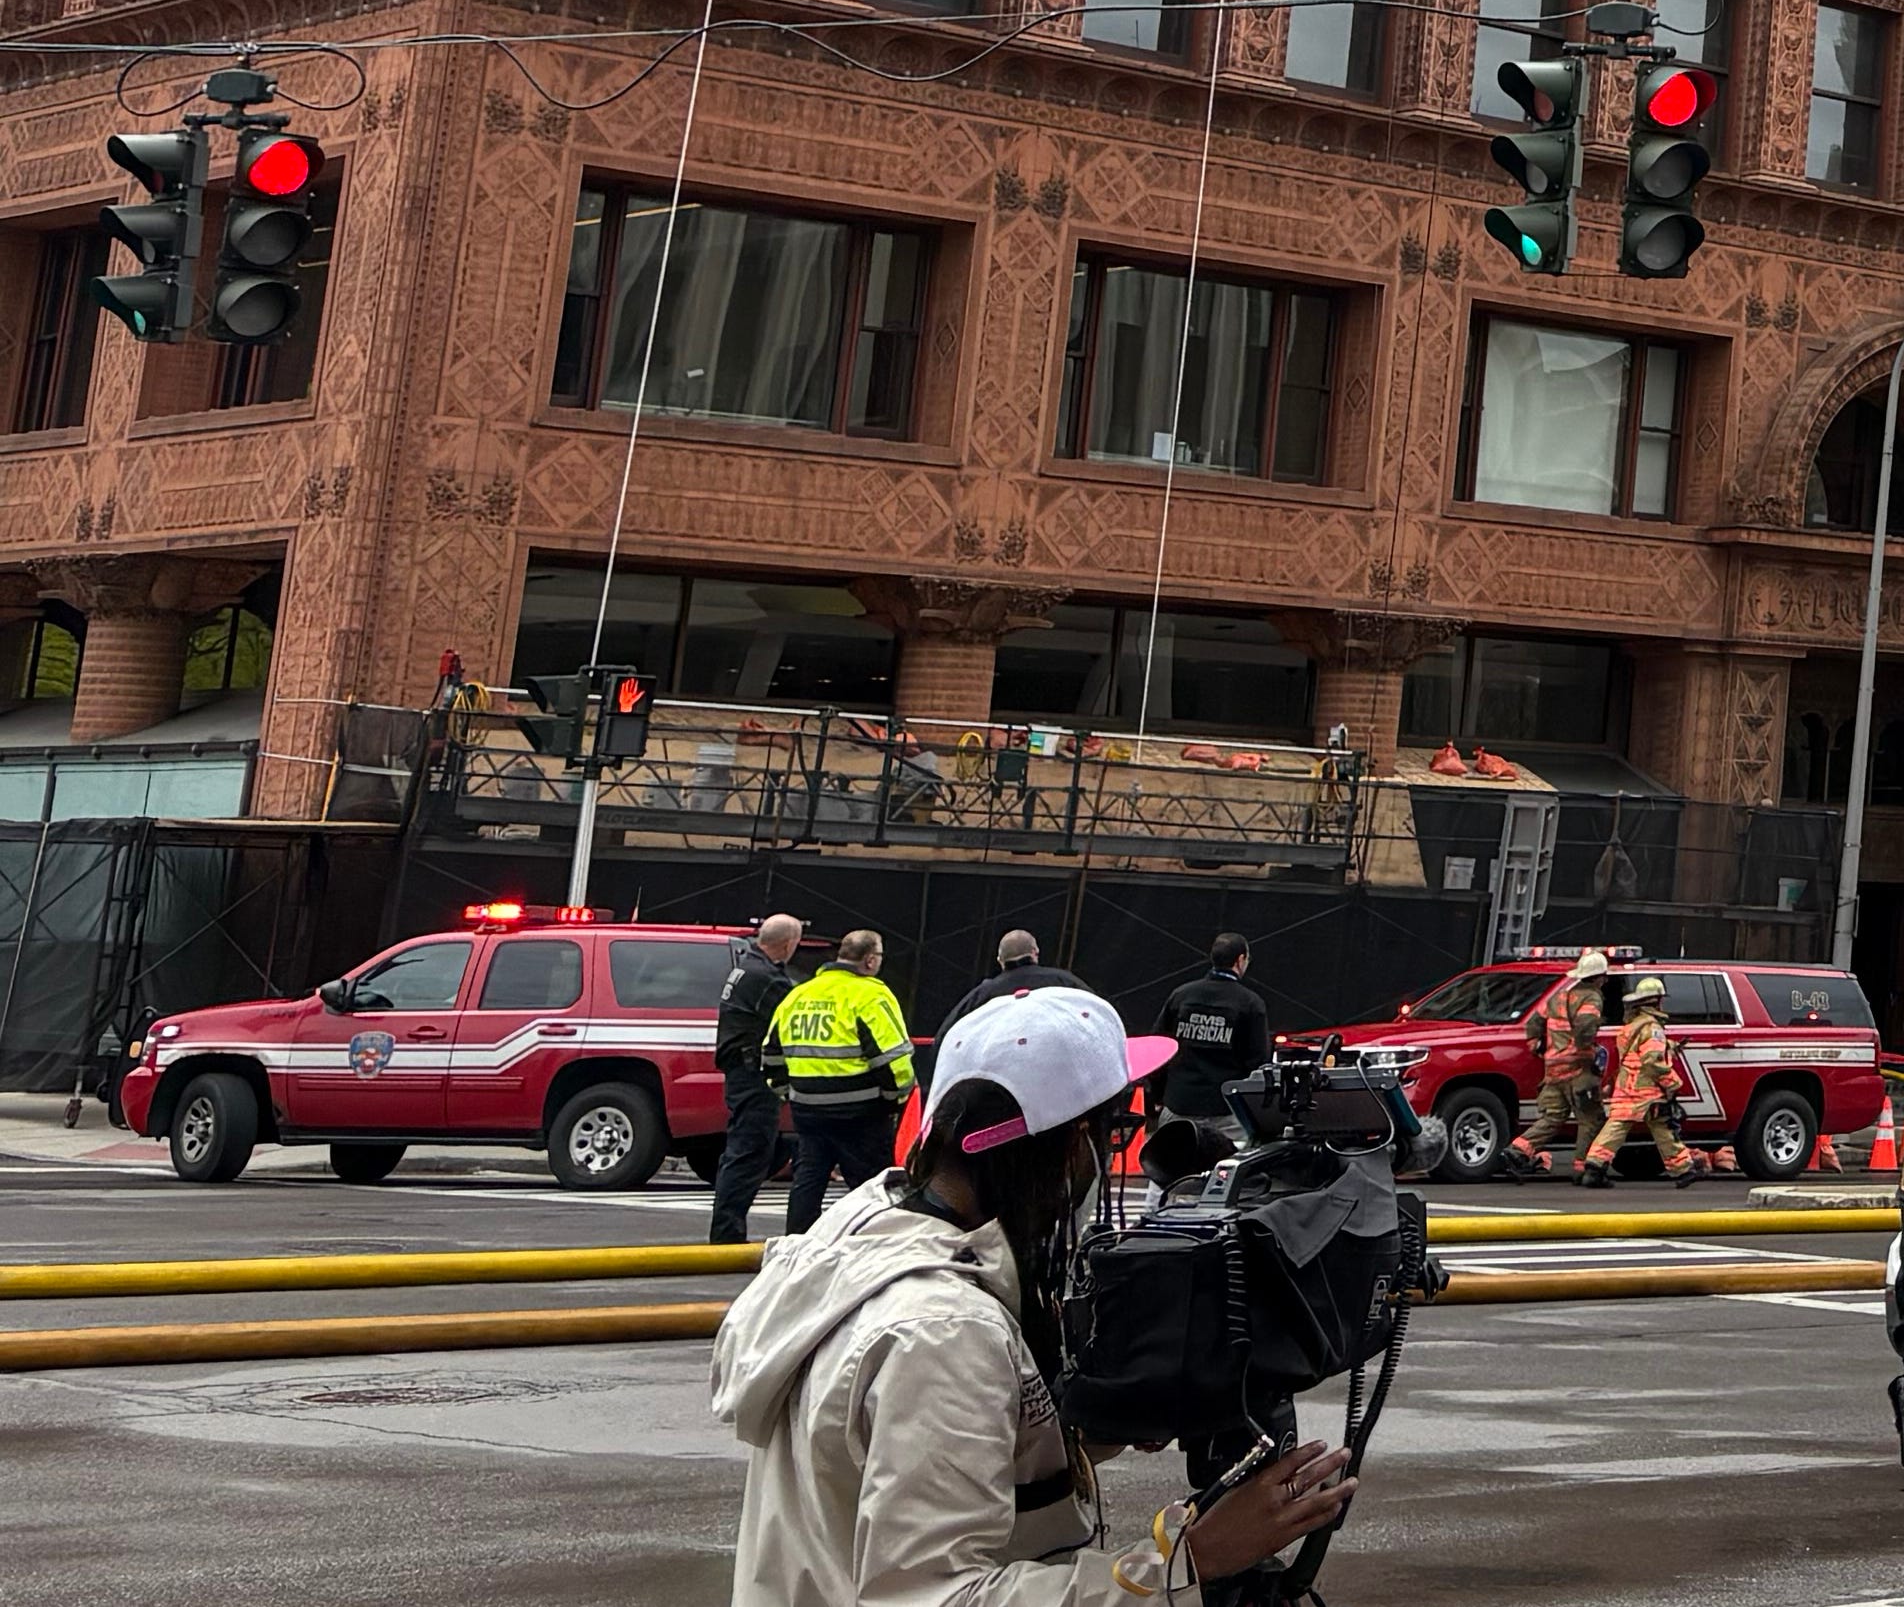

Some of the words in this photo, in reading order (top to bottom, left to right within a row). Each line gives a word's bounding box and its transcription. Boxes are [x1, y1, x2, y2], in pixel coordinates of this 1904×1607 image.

[790, 1013, 835, 1042] EMS
[1190, 1013, 1226, 1027] EMS
[1176, 1021, 1233, 1044] PHYSICIAN
